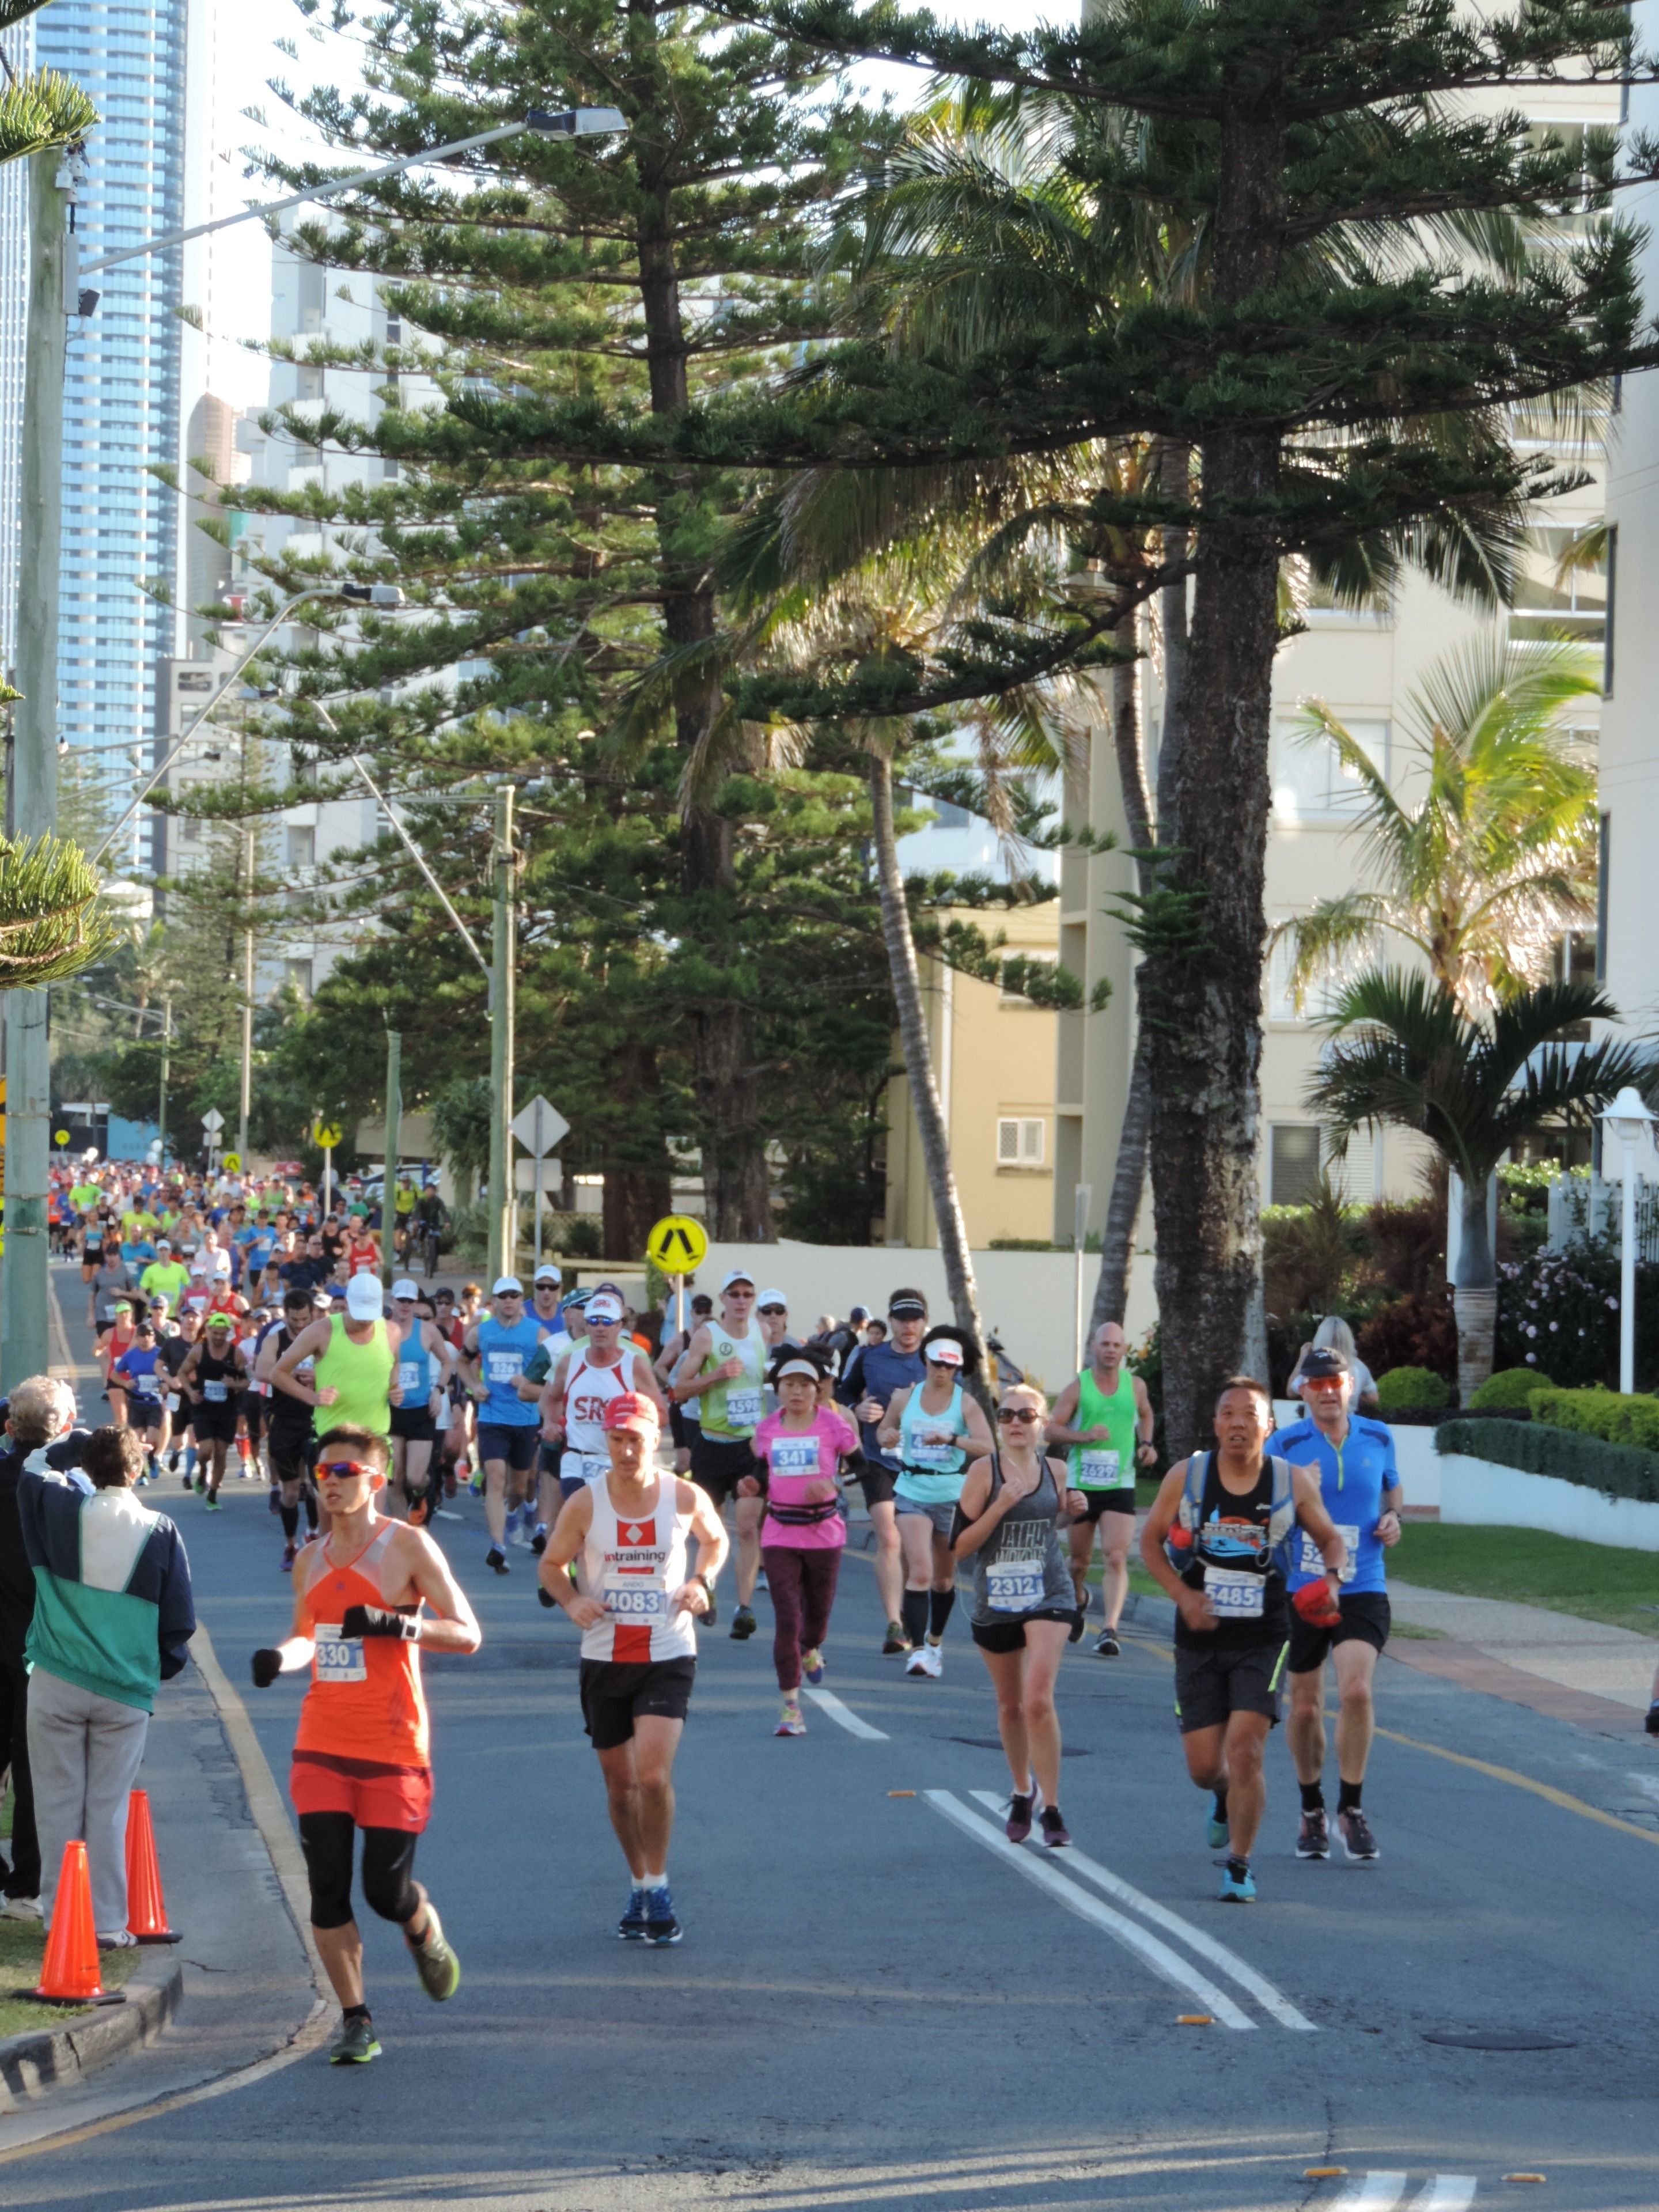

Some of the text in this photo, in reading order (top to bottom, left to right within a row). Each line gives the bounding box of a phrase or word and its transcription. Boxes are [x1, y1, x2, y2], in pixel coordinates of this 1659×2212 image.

[779, 1450, 805, 1465] 341
[1082, 1464, 1113, 1478] 2629
[605, 1550, 665, 1562] intraining
[991, 1577, 1035, 1595] 2312
[606, 1592, 658, 1612] 4083
[1205, 1585, 1255, 1605] 5485
